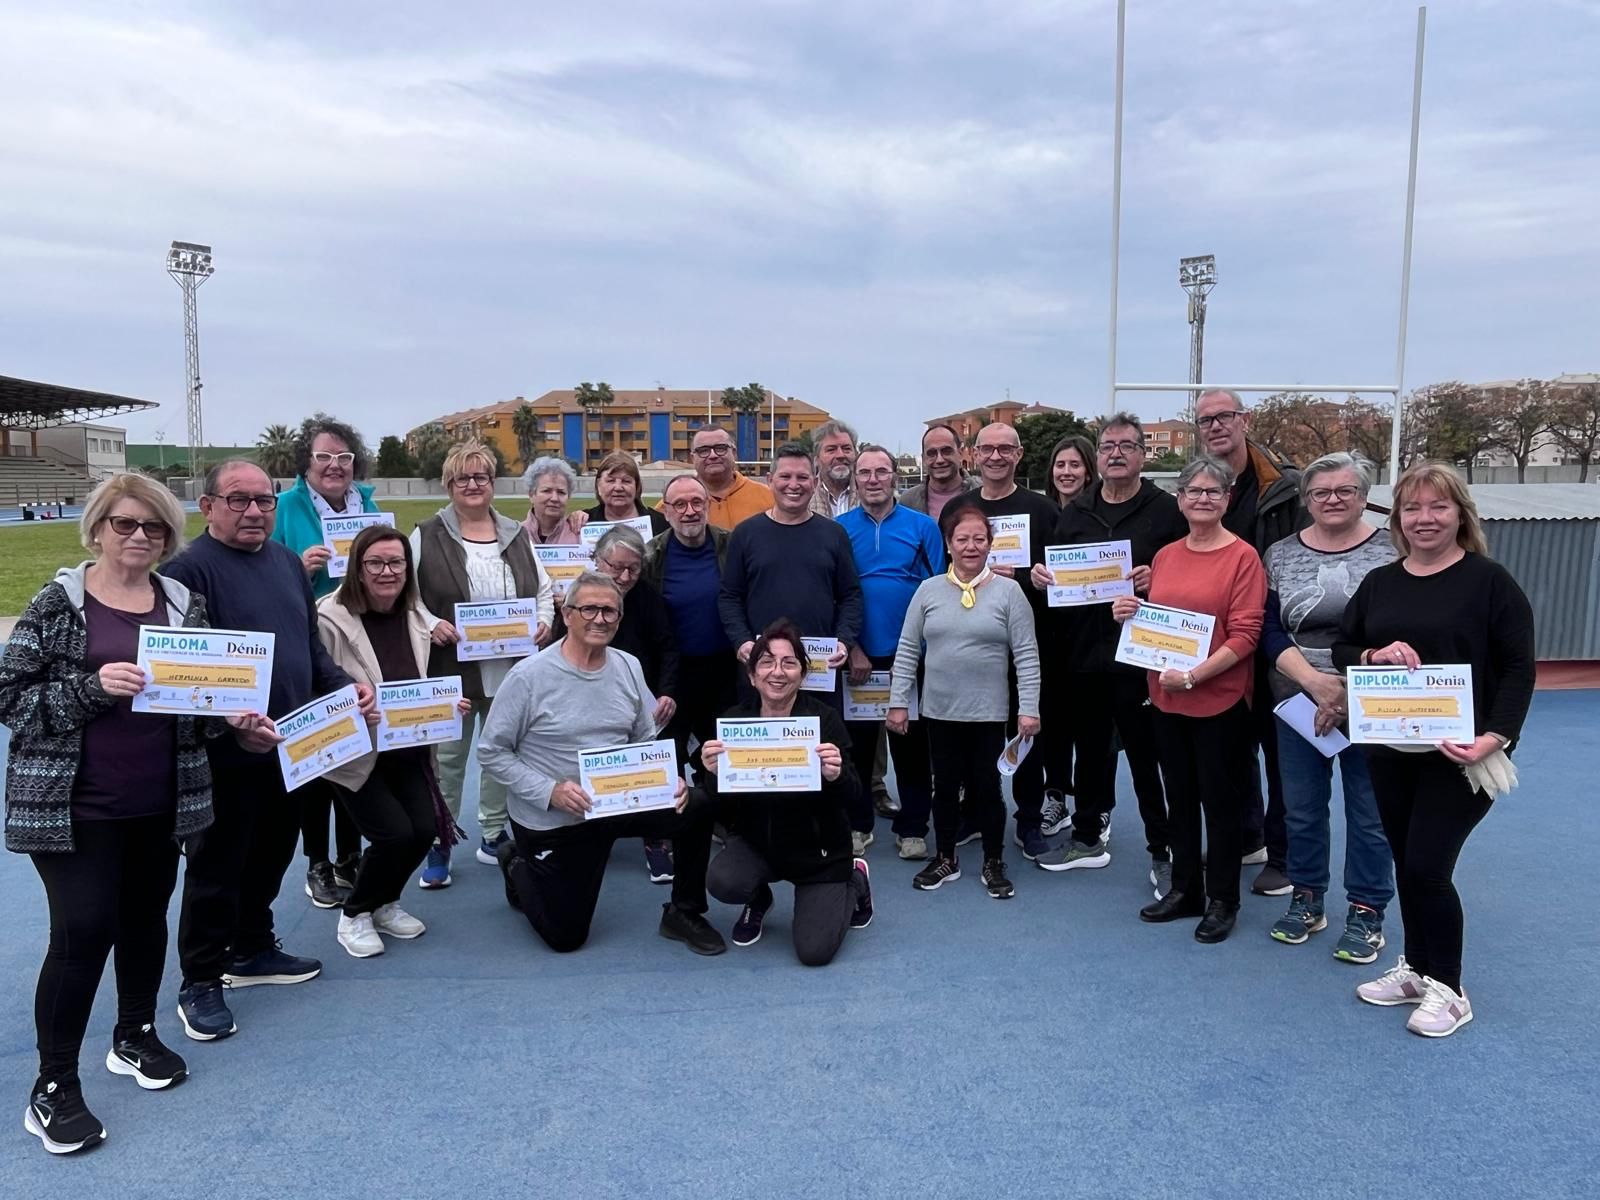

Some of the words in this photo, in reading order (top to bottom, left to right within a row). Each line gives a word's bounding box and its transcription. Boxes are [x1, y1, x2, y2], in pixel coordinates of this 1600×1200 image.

[326, 520, 364, 532] DIPLOMA
[583, 527, 609, 535] DIPLO
[1001, 521, 1026, 530] Dénia
[536, 550, 559, 559] LOMA
[1049, 551, 1088, 562] DIPLOMA
[1098, 548, 1127, 560] Dénia
[459, 608, 497, 618] DIPLOMA
[507, 606, 533, 616] Dénia
[1135, 608, 1170, 624] IPLOMA
[1181, 618, 1209, 633] Dénia
[147, 636, 209, 651] DIPLOMA
[227, 641, 267, 656] Dénia
[807, 643, 833, 653] Dénia
[1354, 675, 1409, 686] DIPLOMA
[1426, 675, 1465, 686] Dénia
[381, 687, 421, 700] DIPLOMA
[432, 685, 458, 696] Dénia
[326, 697, 355, 715] Dénia
[279, 712, 316, 736] DIPLOMA
[722, 727, 769, 737] DIPLOMA
[783, 726, 815, 737] Dénia
[584, 754, 628, 768] DIPLOMA
[640, 750, 671, 762] Dénia
